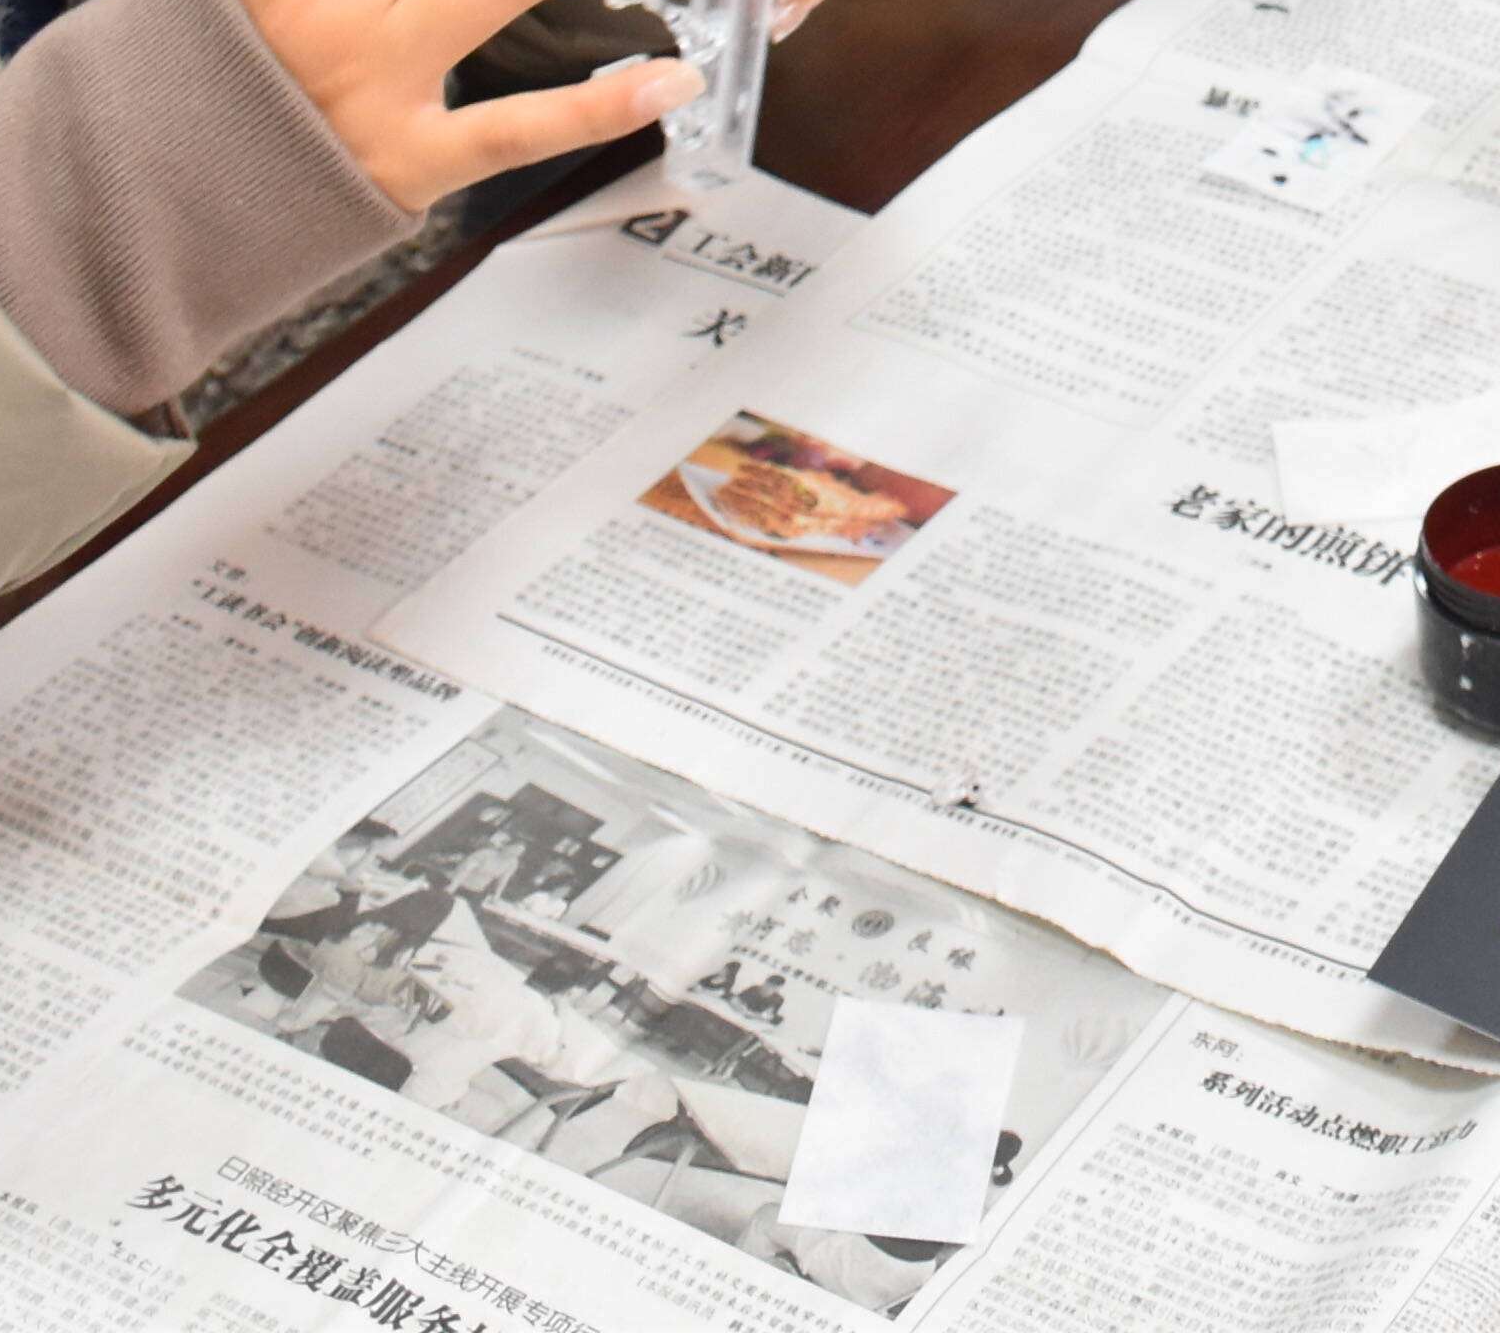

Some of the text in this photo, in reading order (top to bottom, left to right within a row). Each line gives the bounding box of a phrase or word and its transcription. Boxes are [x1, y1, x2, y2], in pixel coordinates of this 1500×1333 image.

[125, 1174, 490, 1333] 多元化全覆盖服务
